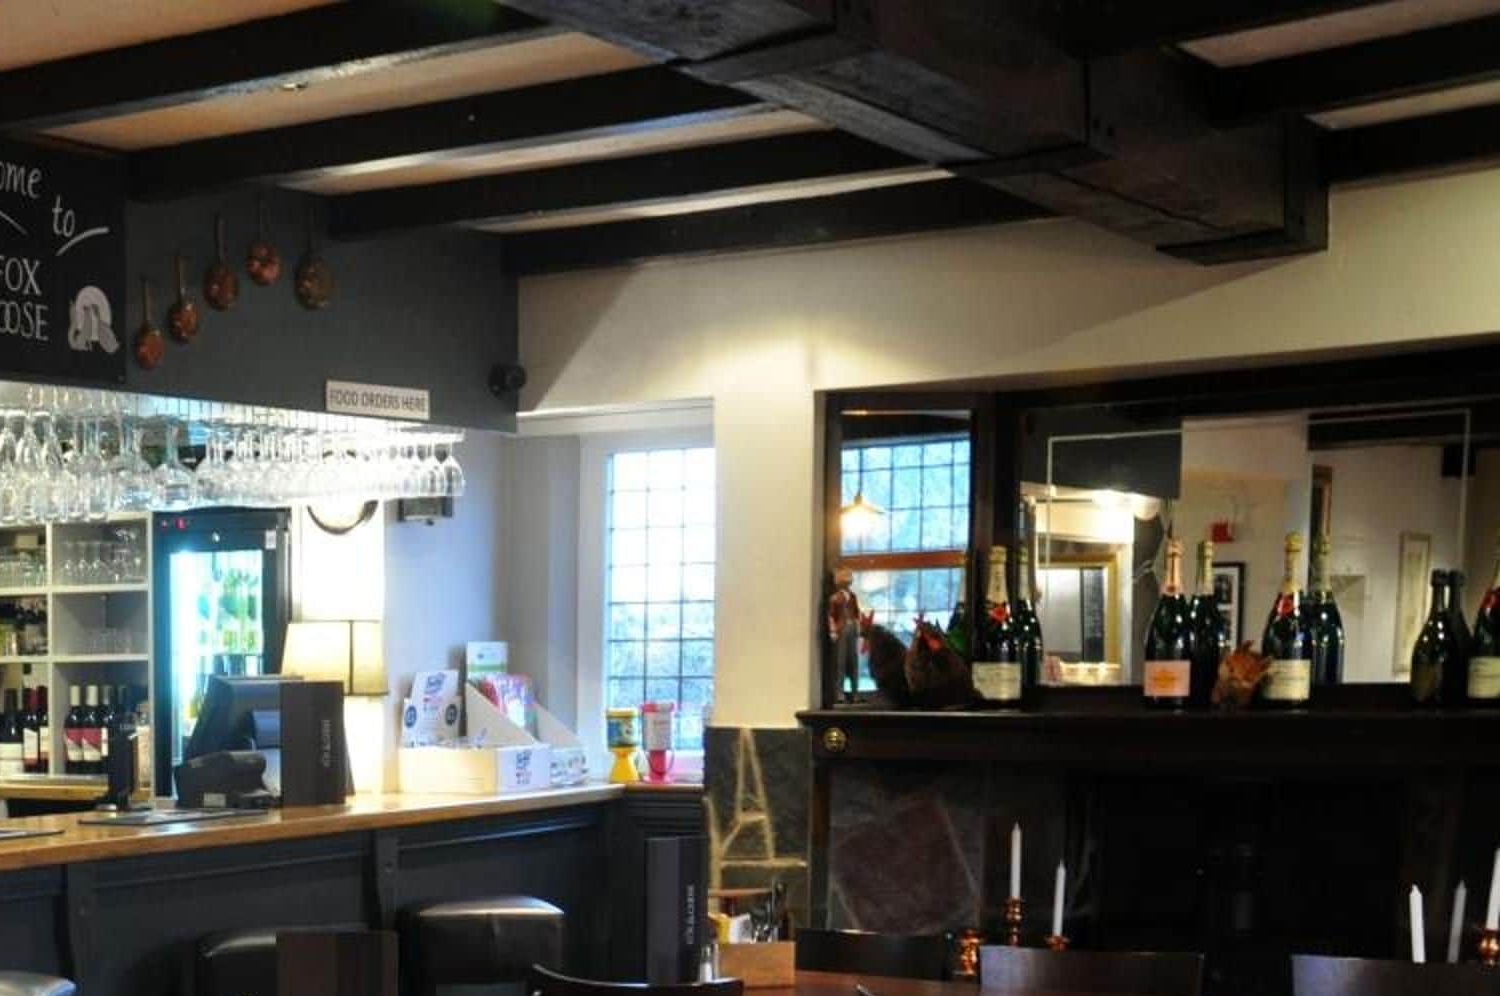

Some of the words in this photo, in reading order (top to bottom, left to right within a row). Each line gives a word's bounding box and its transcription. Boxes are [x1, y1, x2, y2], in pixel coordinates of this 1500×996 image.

[52, 194, 76, 238] to
[329, 389, 358, 406] FOOD
[361, 391, 401, 410] ORDERS
[402, 394, 426, 413] HERE
